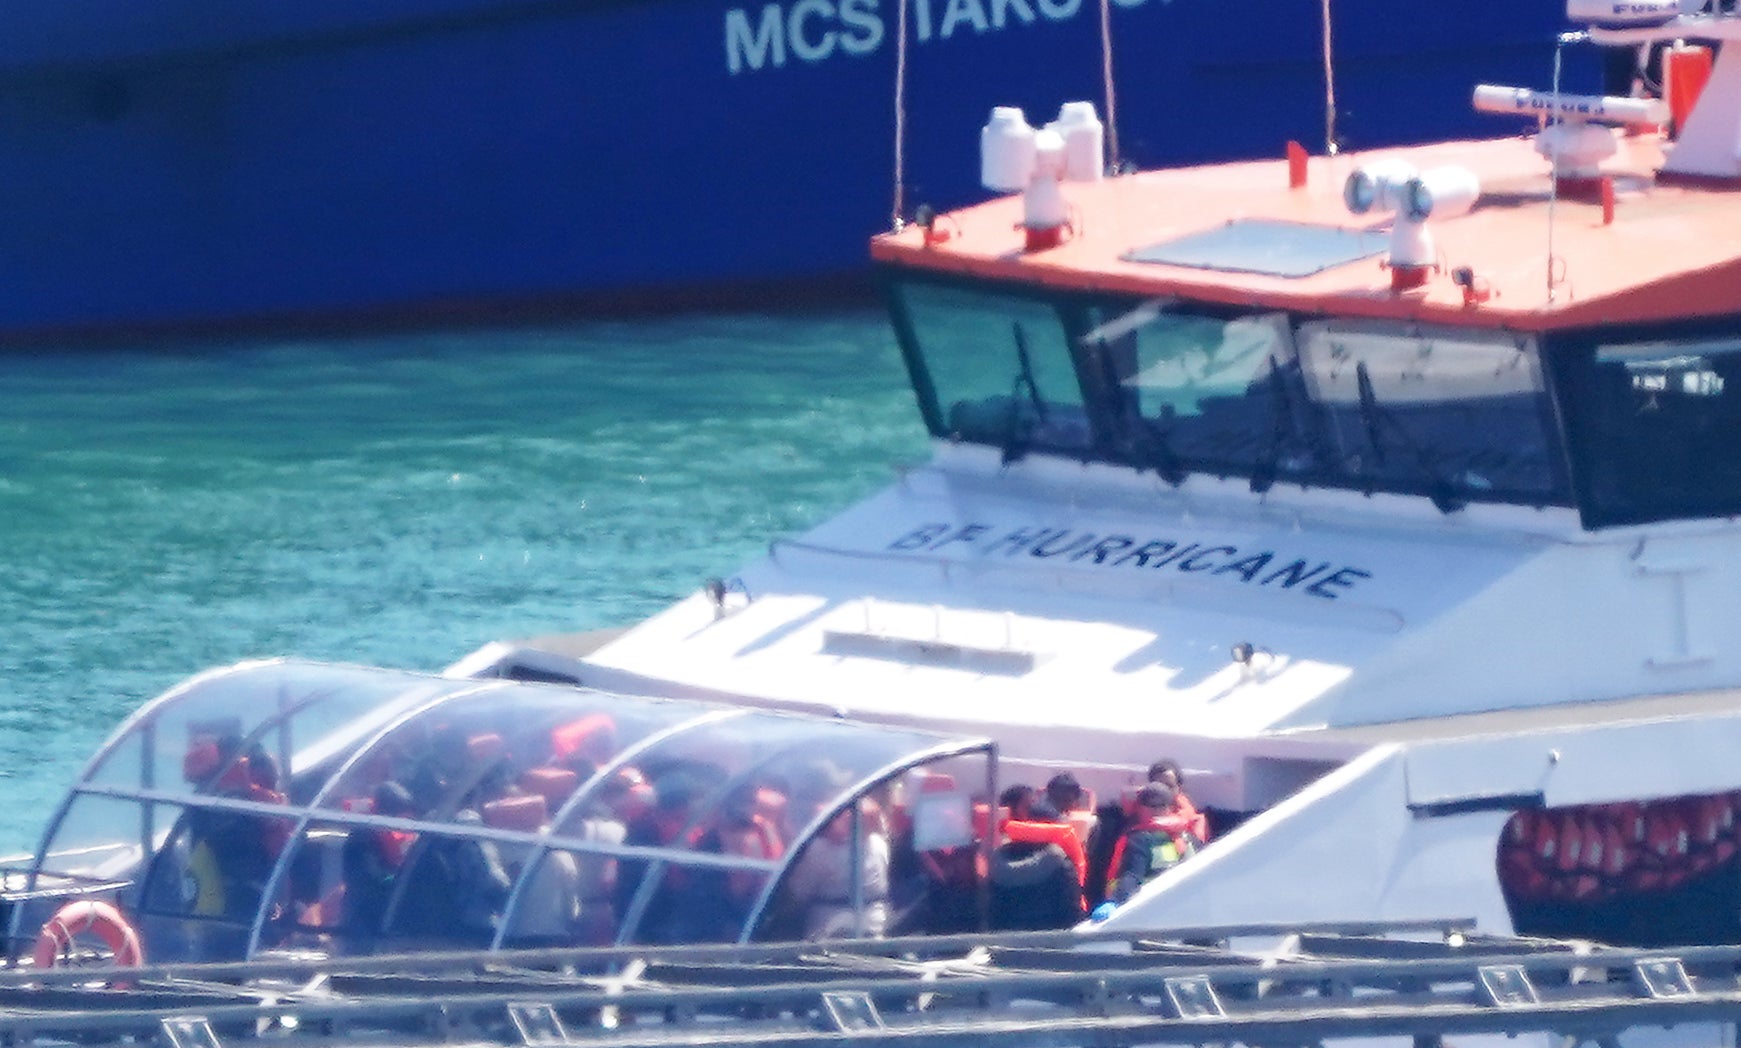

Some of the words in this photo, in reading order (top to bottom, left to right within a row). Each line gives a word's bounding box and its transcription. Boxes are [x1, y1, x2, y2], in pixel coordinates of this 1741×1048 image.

[724, 0, 886, 74] MCS
[887, 522, 994, 552] BF
[983, 525, 1373, 600] HURRICANE
